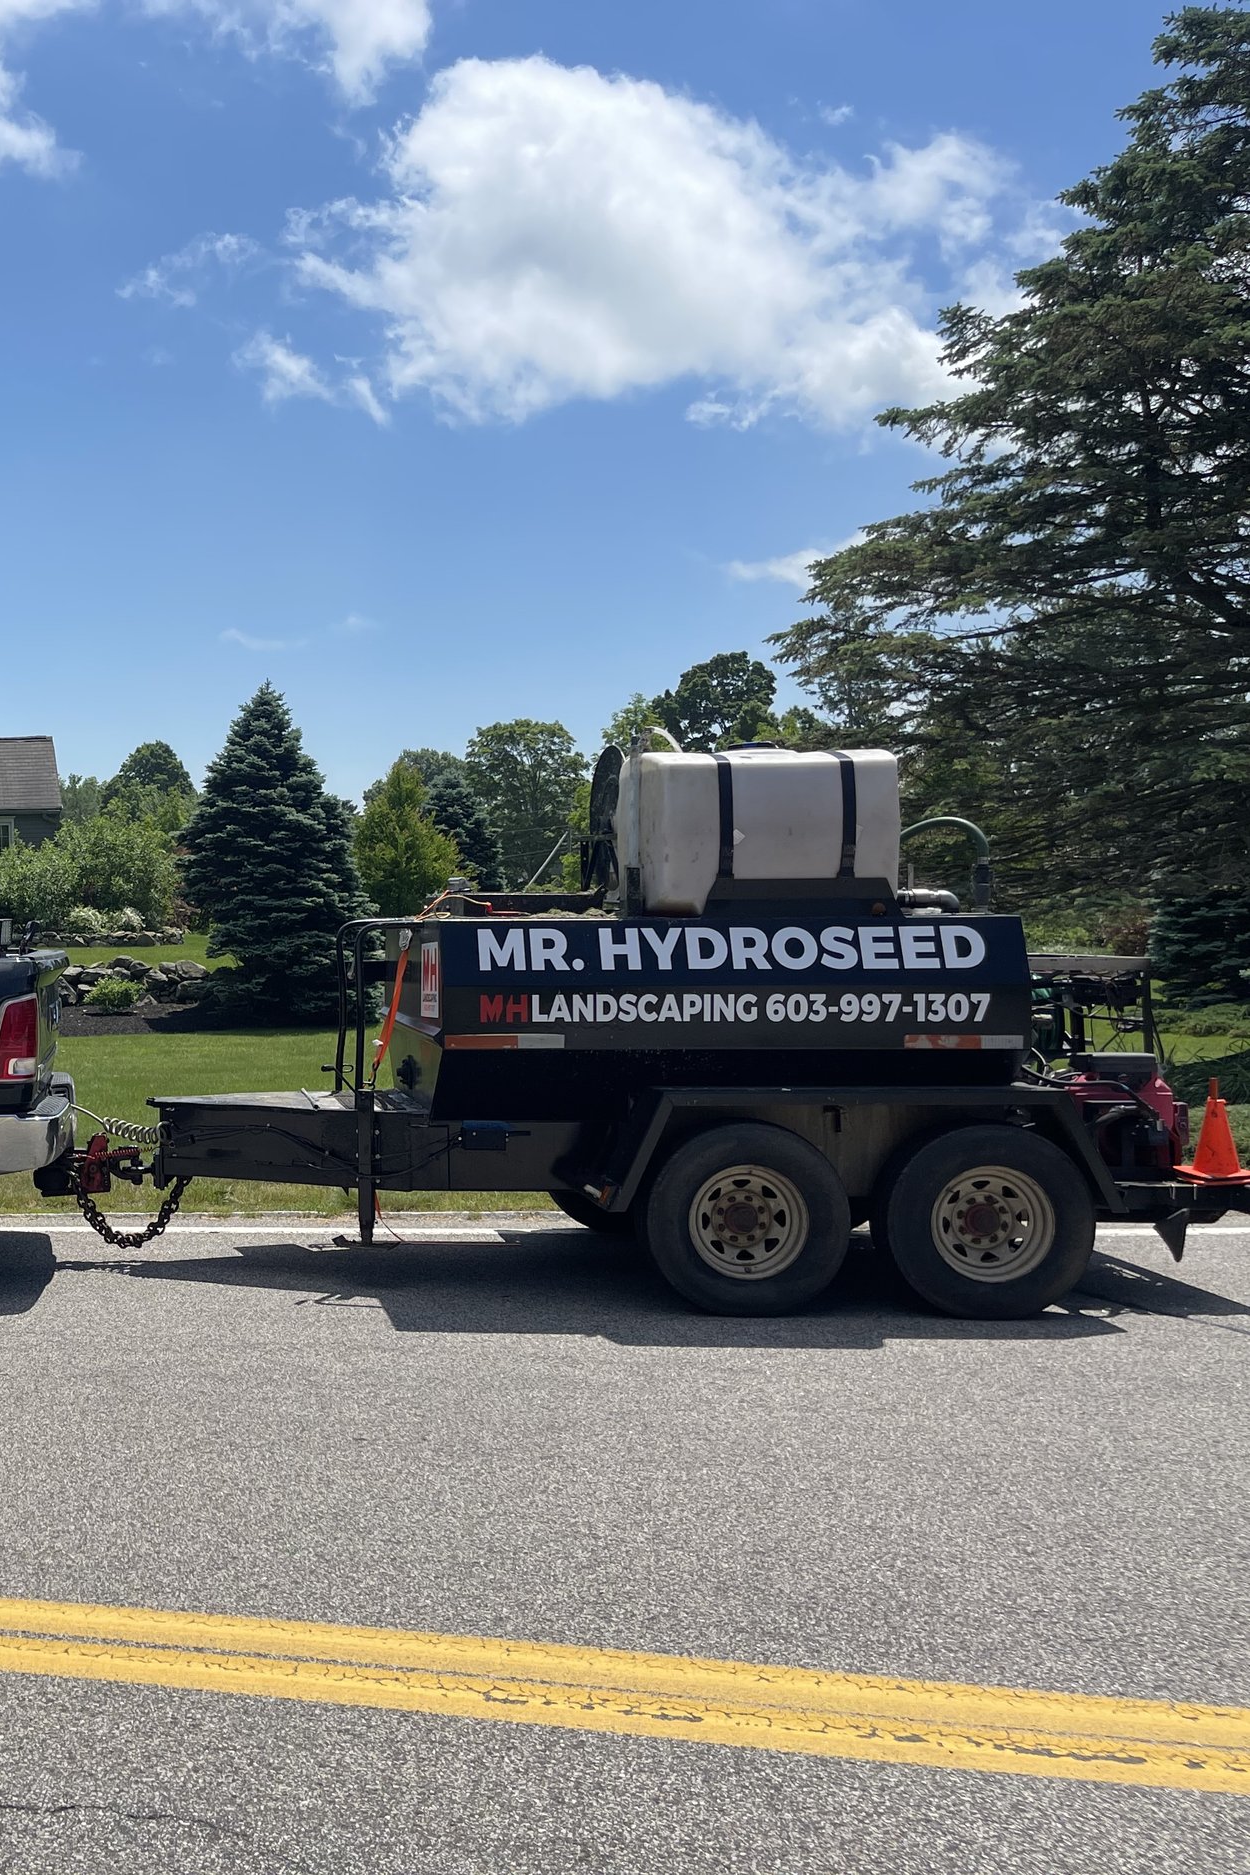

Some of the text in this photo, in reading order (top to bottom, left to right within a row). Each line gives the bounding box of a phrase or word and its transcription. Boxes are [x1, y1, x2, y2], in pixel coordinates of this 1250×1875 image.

[477, 926, 986, 971] MR. HYDROSEED
[766, 993, 991, 1022] 603-997-1307
